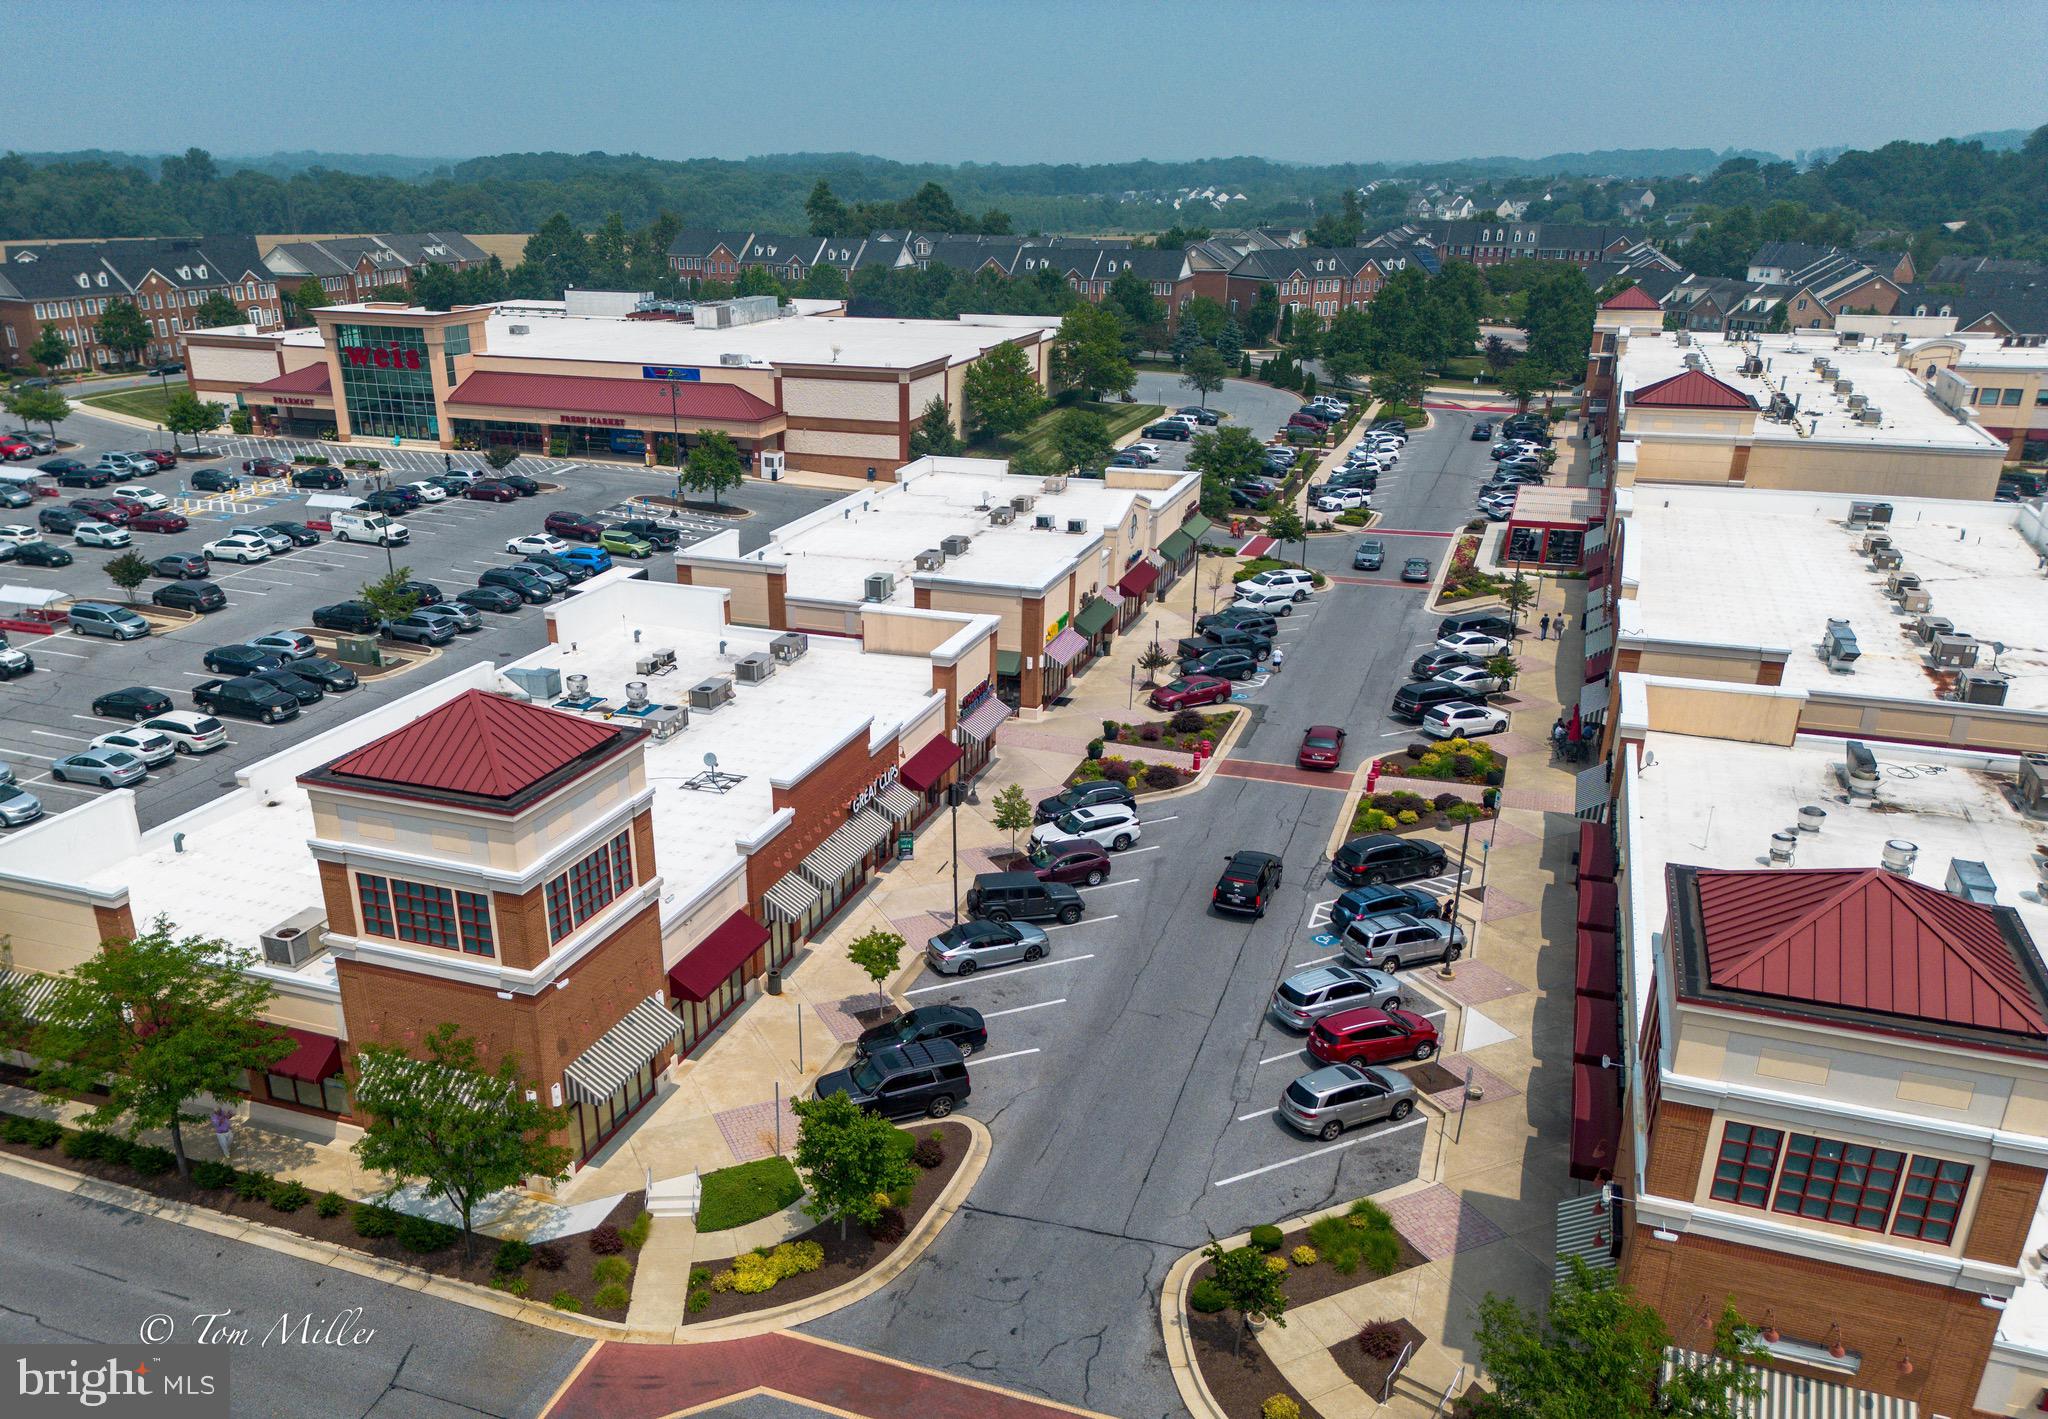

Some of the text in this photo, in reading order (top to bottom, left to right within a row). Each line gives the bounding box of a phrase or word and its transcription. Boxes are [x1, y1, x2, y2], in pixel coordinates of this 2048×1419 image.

[343, 341, 421, 370] weis
[853, 764, 899, 813] GREAT CLIPS
